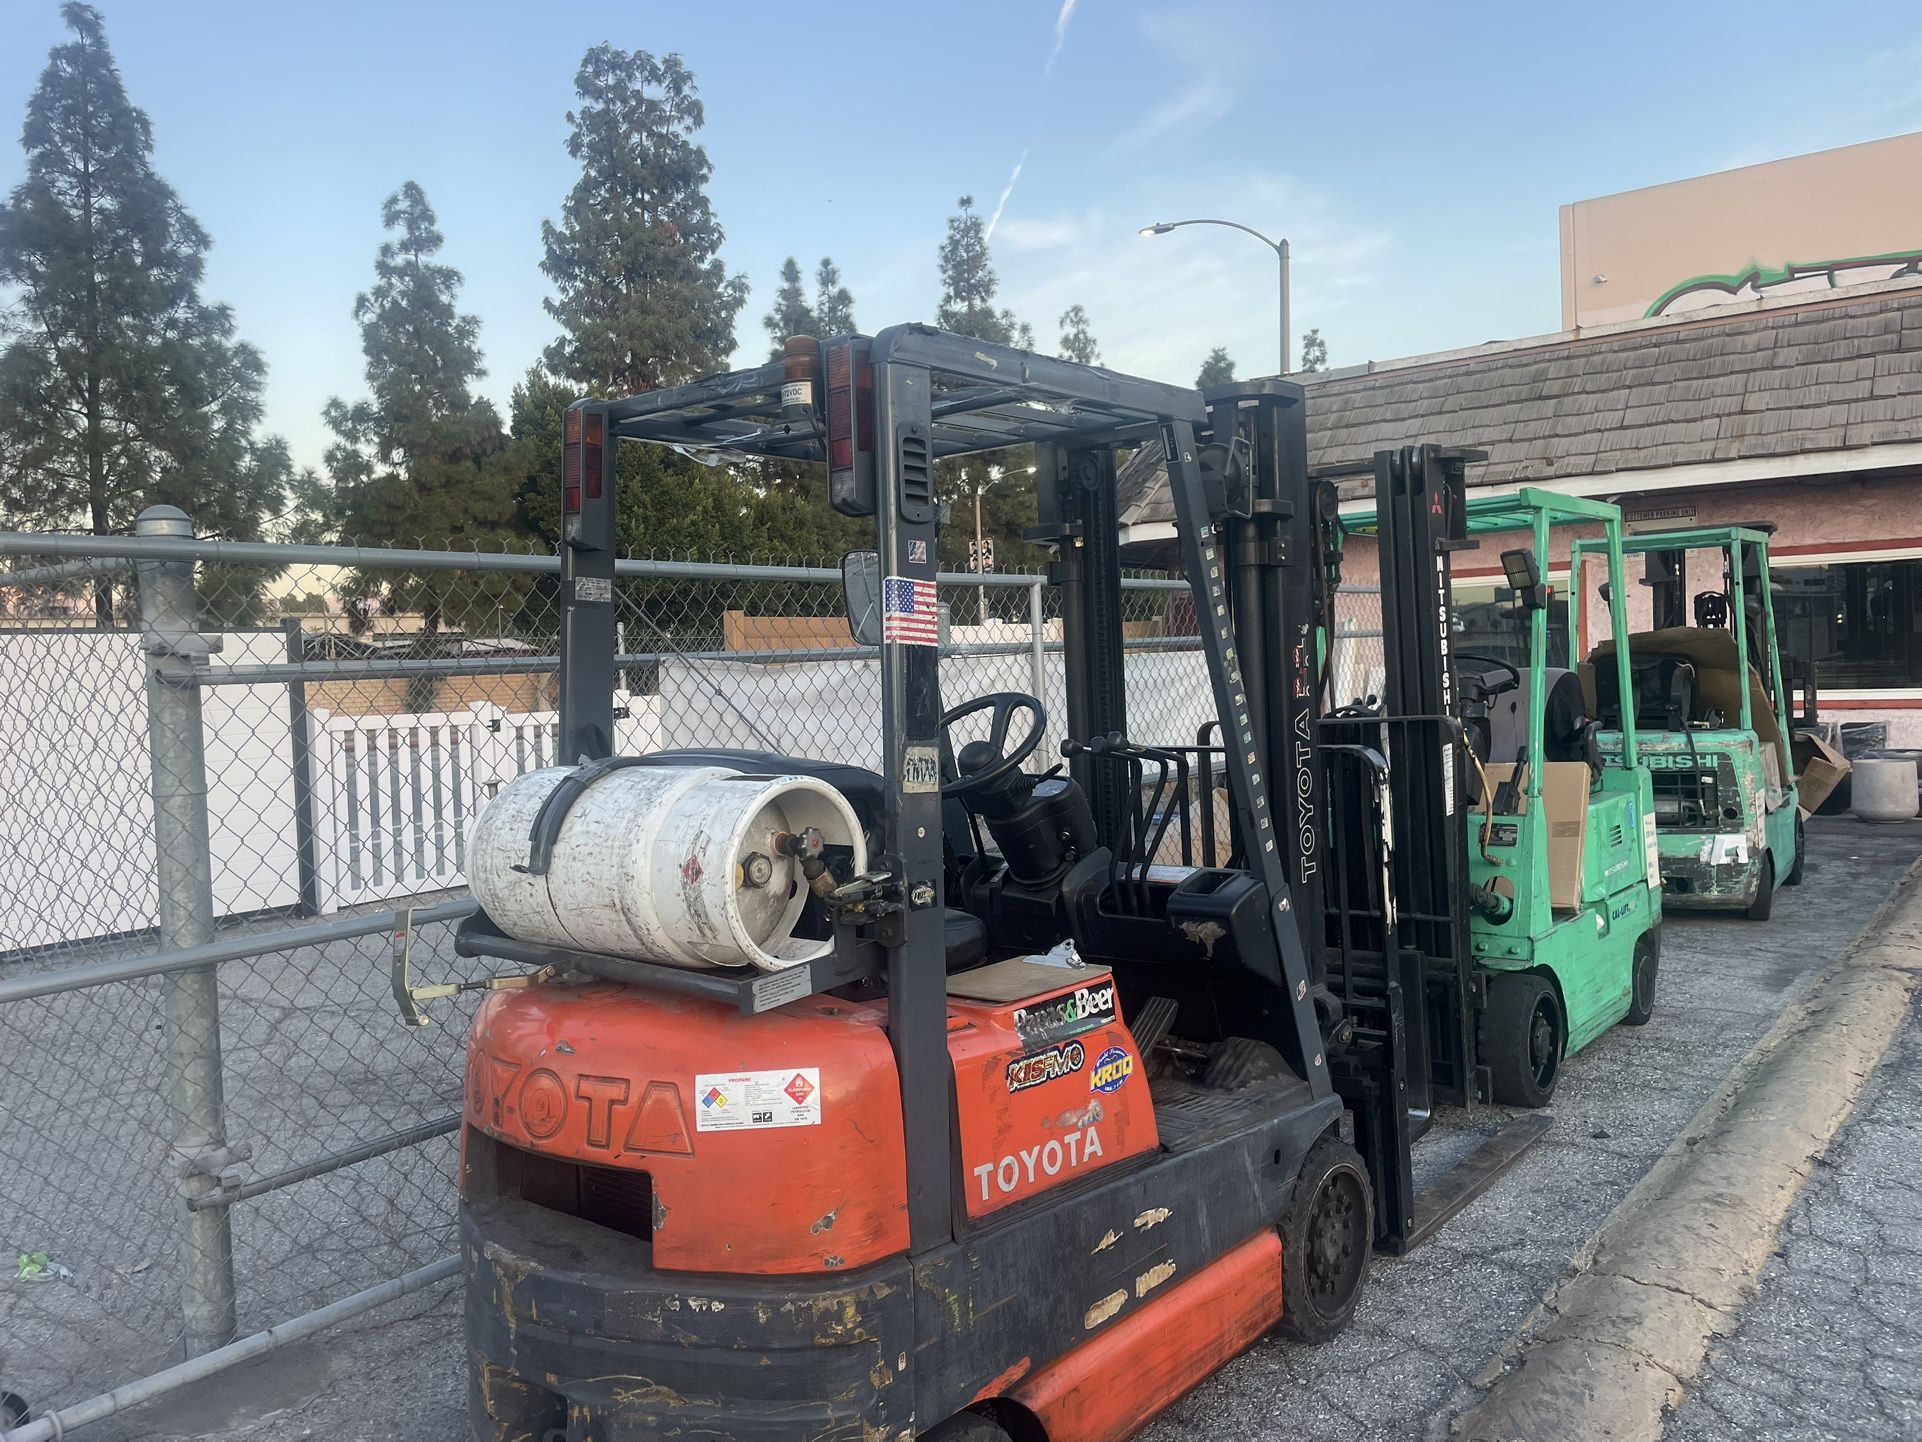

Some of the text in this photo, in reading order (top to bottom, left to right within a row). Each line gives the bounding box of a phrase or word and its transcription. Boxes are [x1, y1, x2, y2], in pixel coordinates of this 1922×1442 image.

[1656, 508, 1680, 518] PARKING
[1436, 555, 1450, 716] MITSUBISHI
[1295, 708, 1317, 883] TOYOTA
[974, 1126, 1103, 1200] TOYOTA
